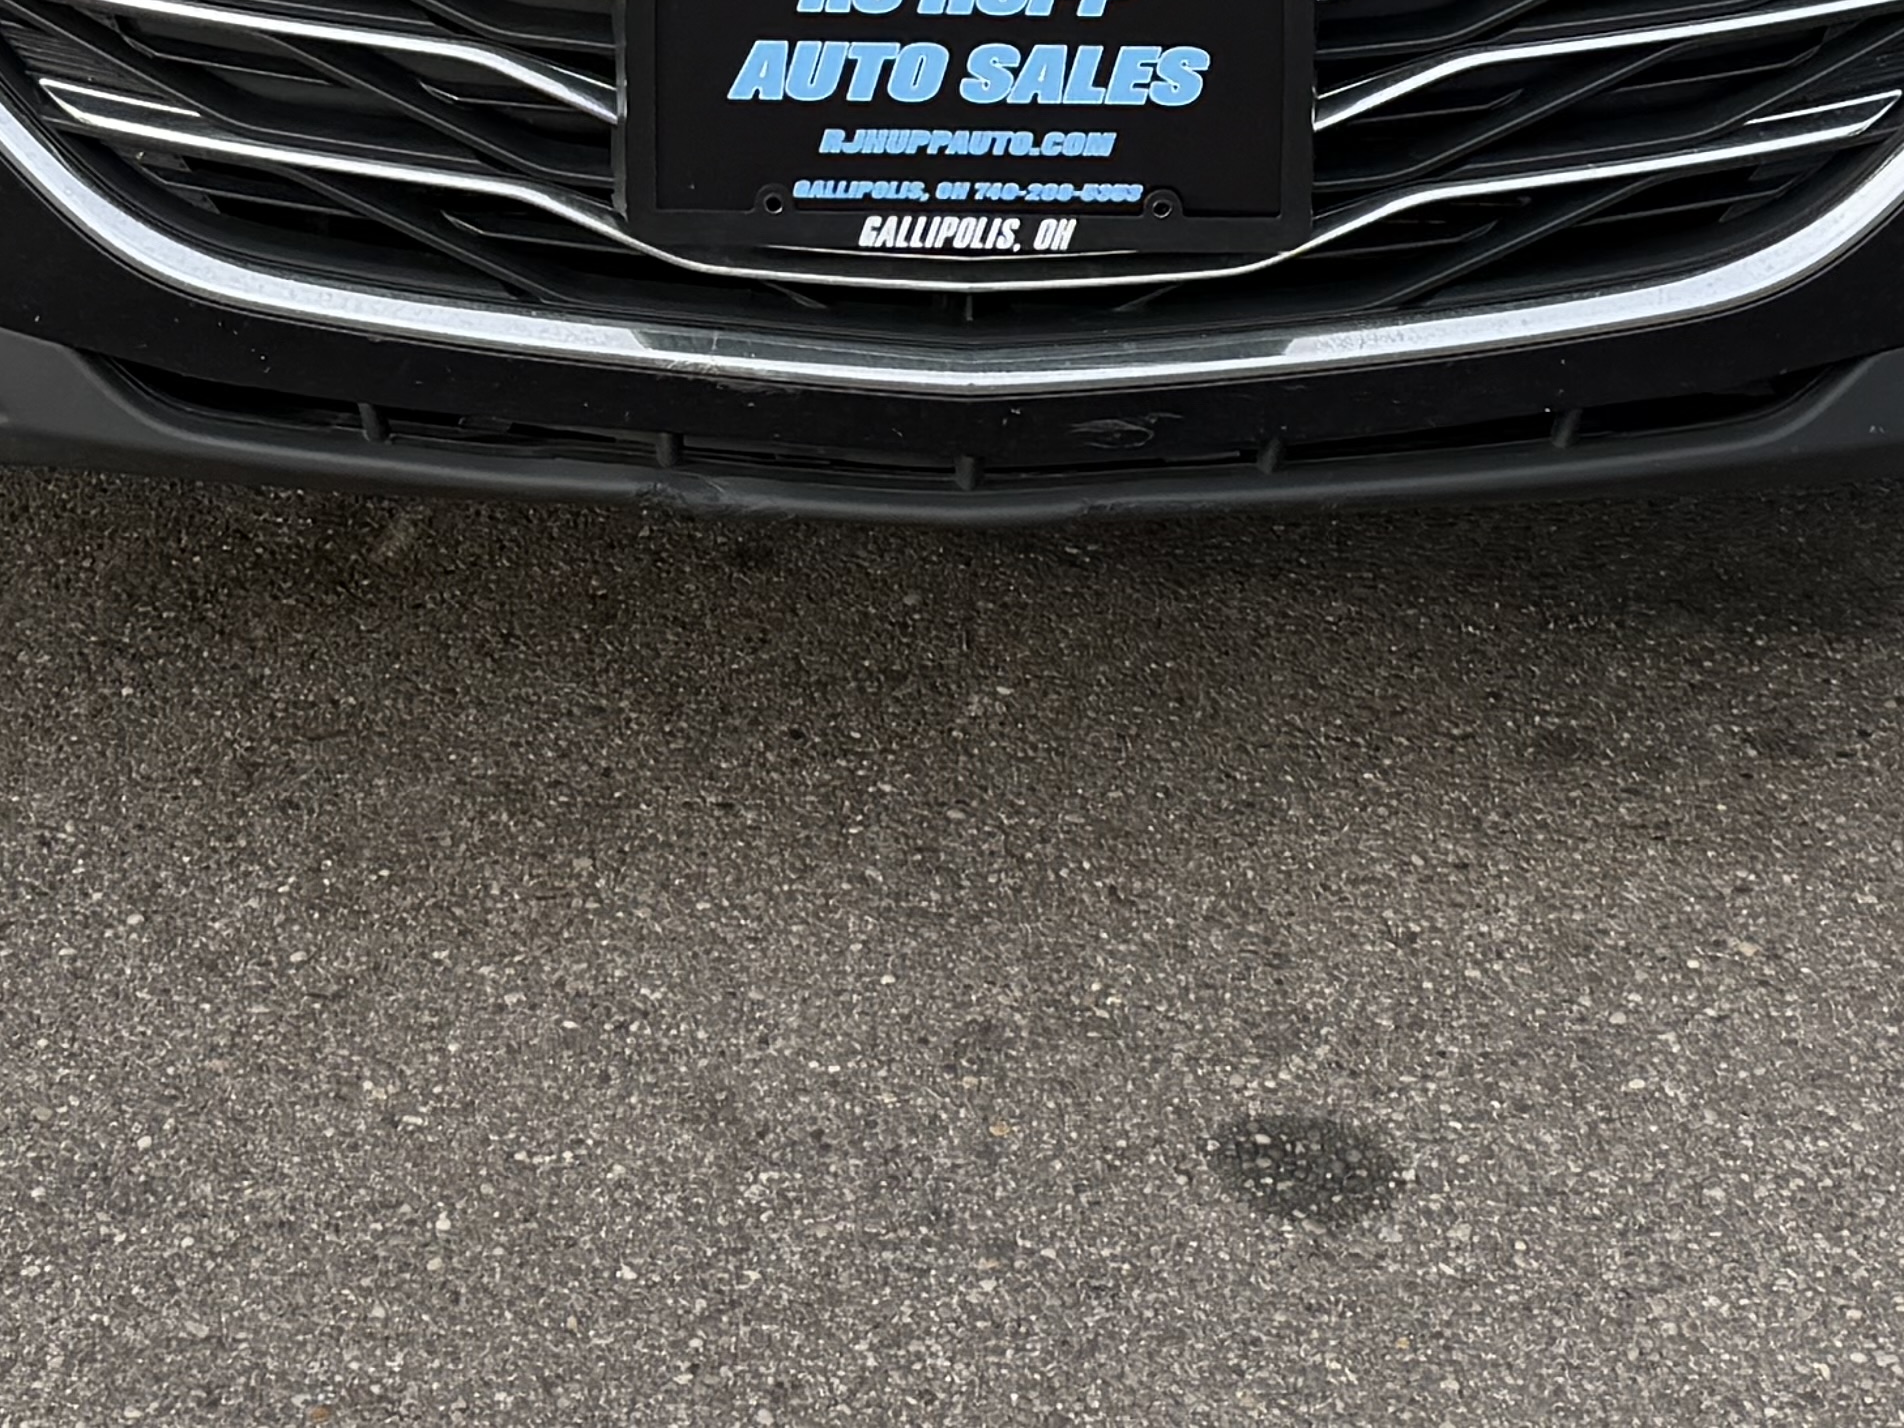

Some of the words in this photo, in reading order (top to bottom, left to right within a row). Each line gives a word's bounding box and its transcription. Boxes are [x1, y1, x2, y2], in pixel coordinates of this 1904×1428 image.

[726, 39, 950, 104] AUTO
[958, 42, 1211, 107] SALES
[818, 128, 1118, 157] RJHUPPAUTO.COM
[934, 181, 972, 201] OH
[857, 214, 1022, 253] GALLIPOLIS,
[1032, 217, 1078, 252] OH
